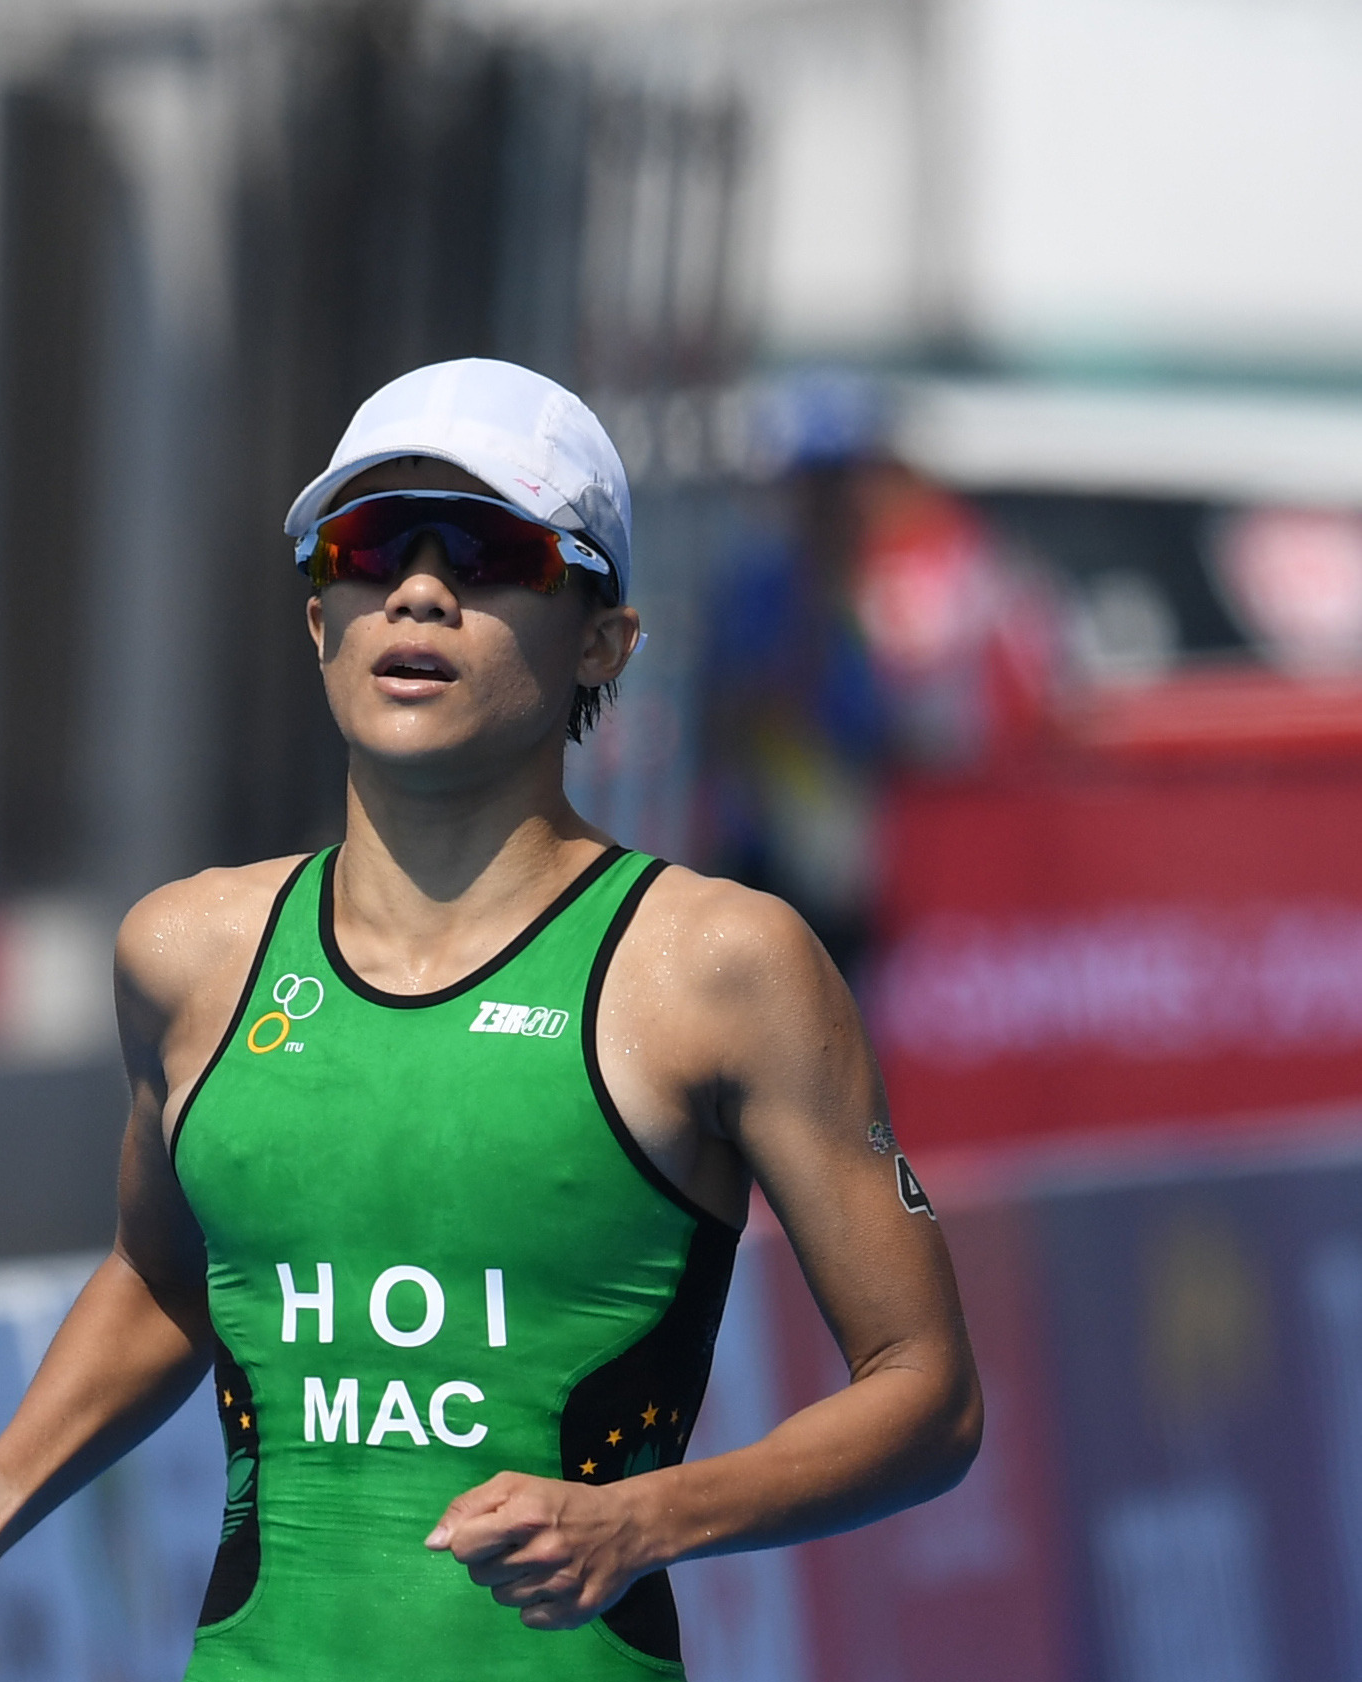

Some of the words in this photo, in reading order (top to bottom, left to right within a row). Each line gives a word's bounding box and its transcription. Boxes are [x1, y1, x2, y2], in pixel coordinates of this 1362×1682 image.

[284, 1042, 304, 1053] ITU
[275, 1262, 507, 1348] HOI
[304, 1376, 488, 1448] MAC
